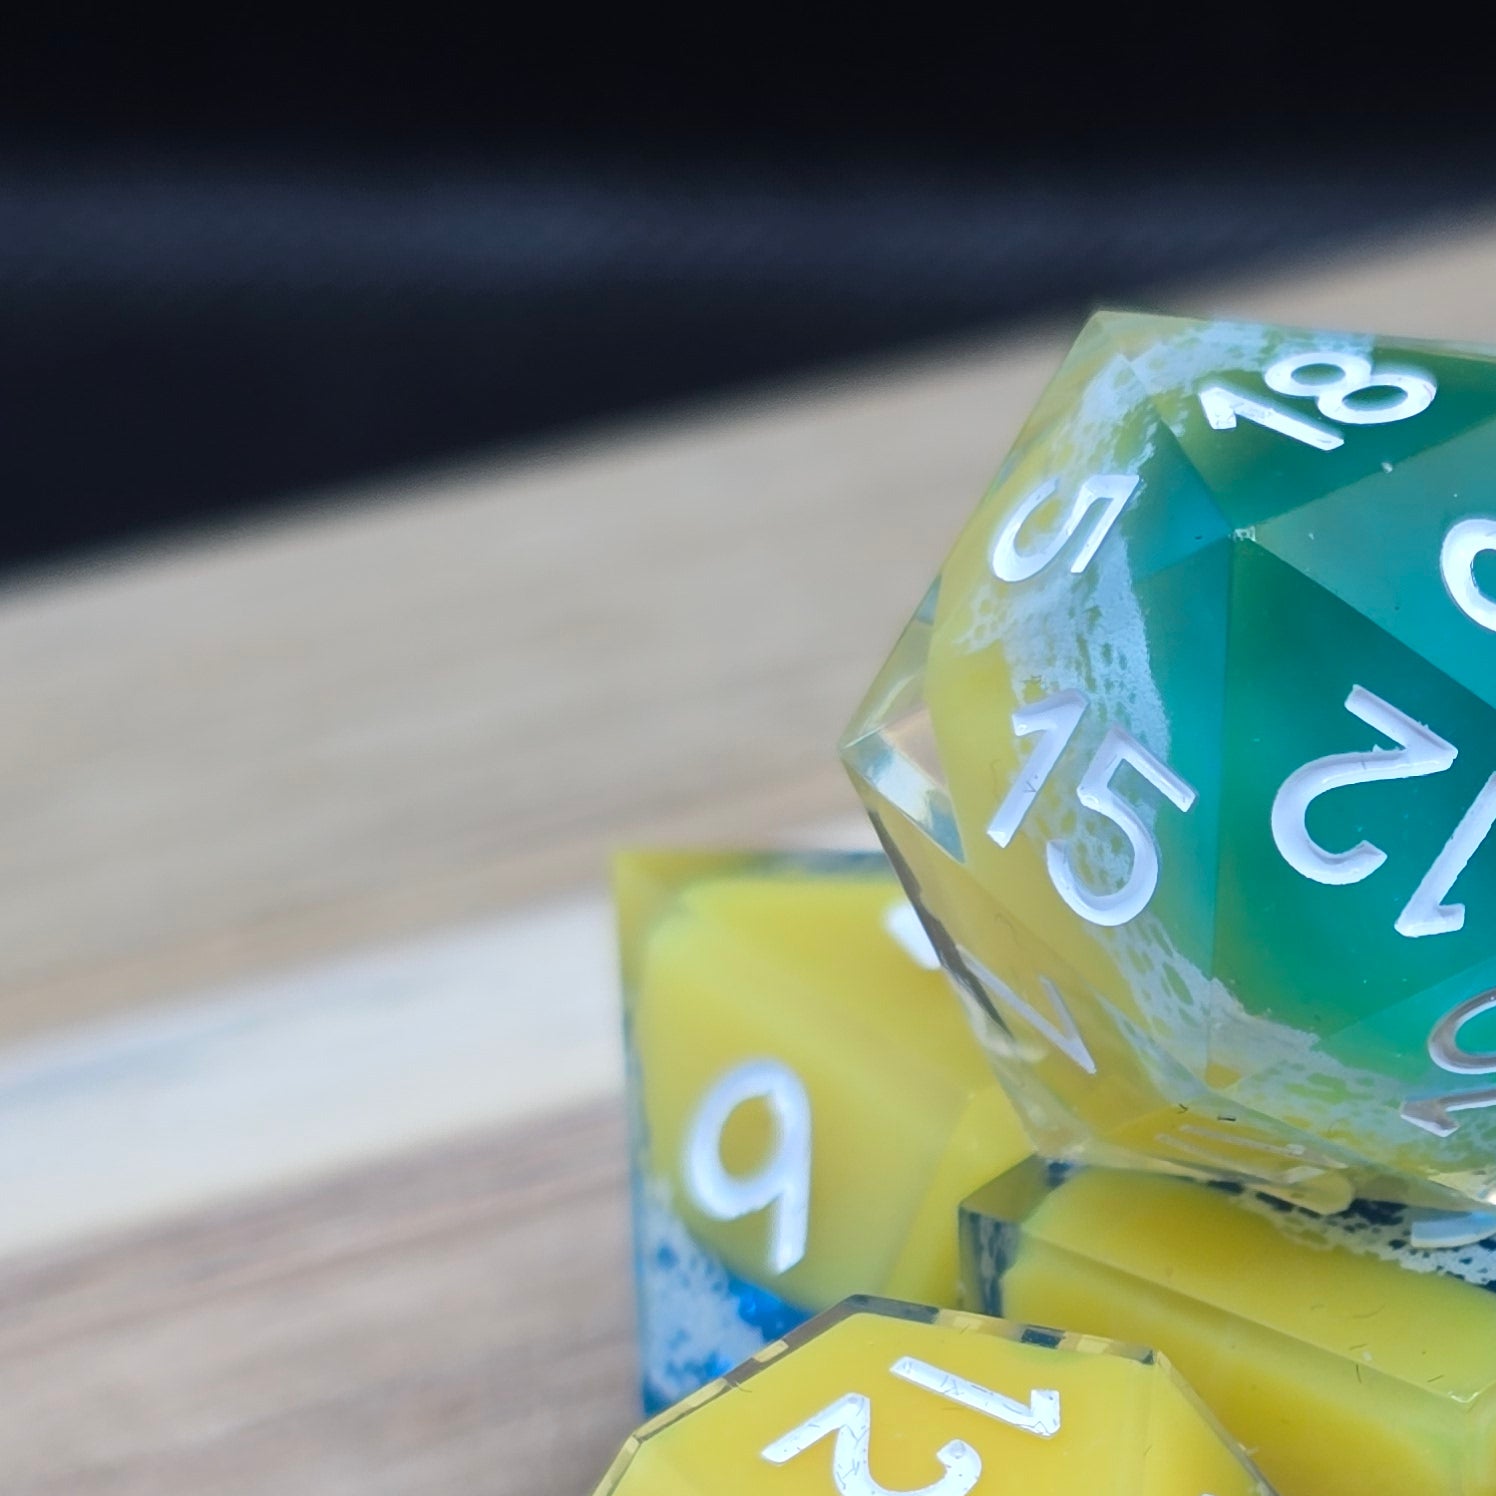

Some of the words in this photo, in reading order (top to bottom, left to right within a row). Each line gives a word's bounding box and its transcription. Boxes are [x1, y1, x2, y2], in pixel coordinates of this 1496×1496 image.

[1202, 351, 1438, 450] 18
[991, 474, 1140, 582] 5
[988, 687, 1199, 927] 15
